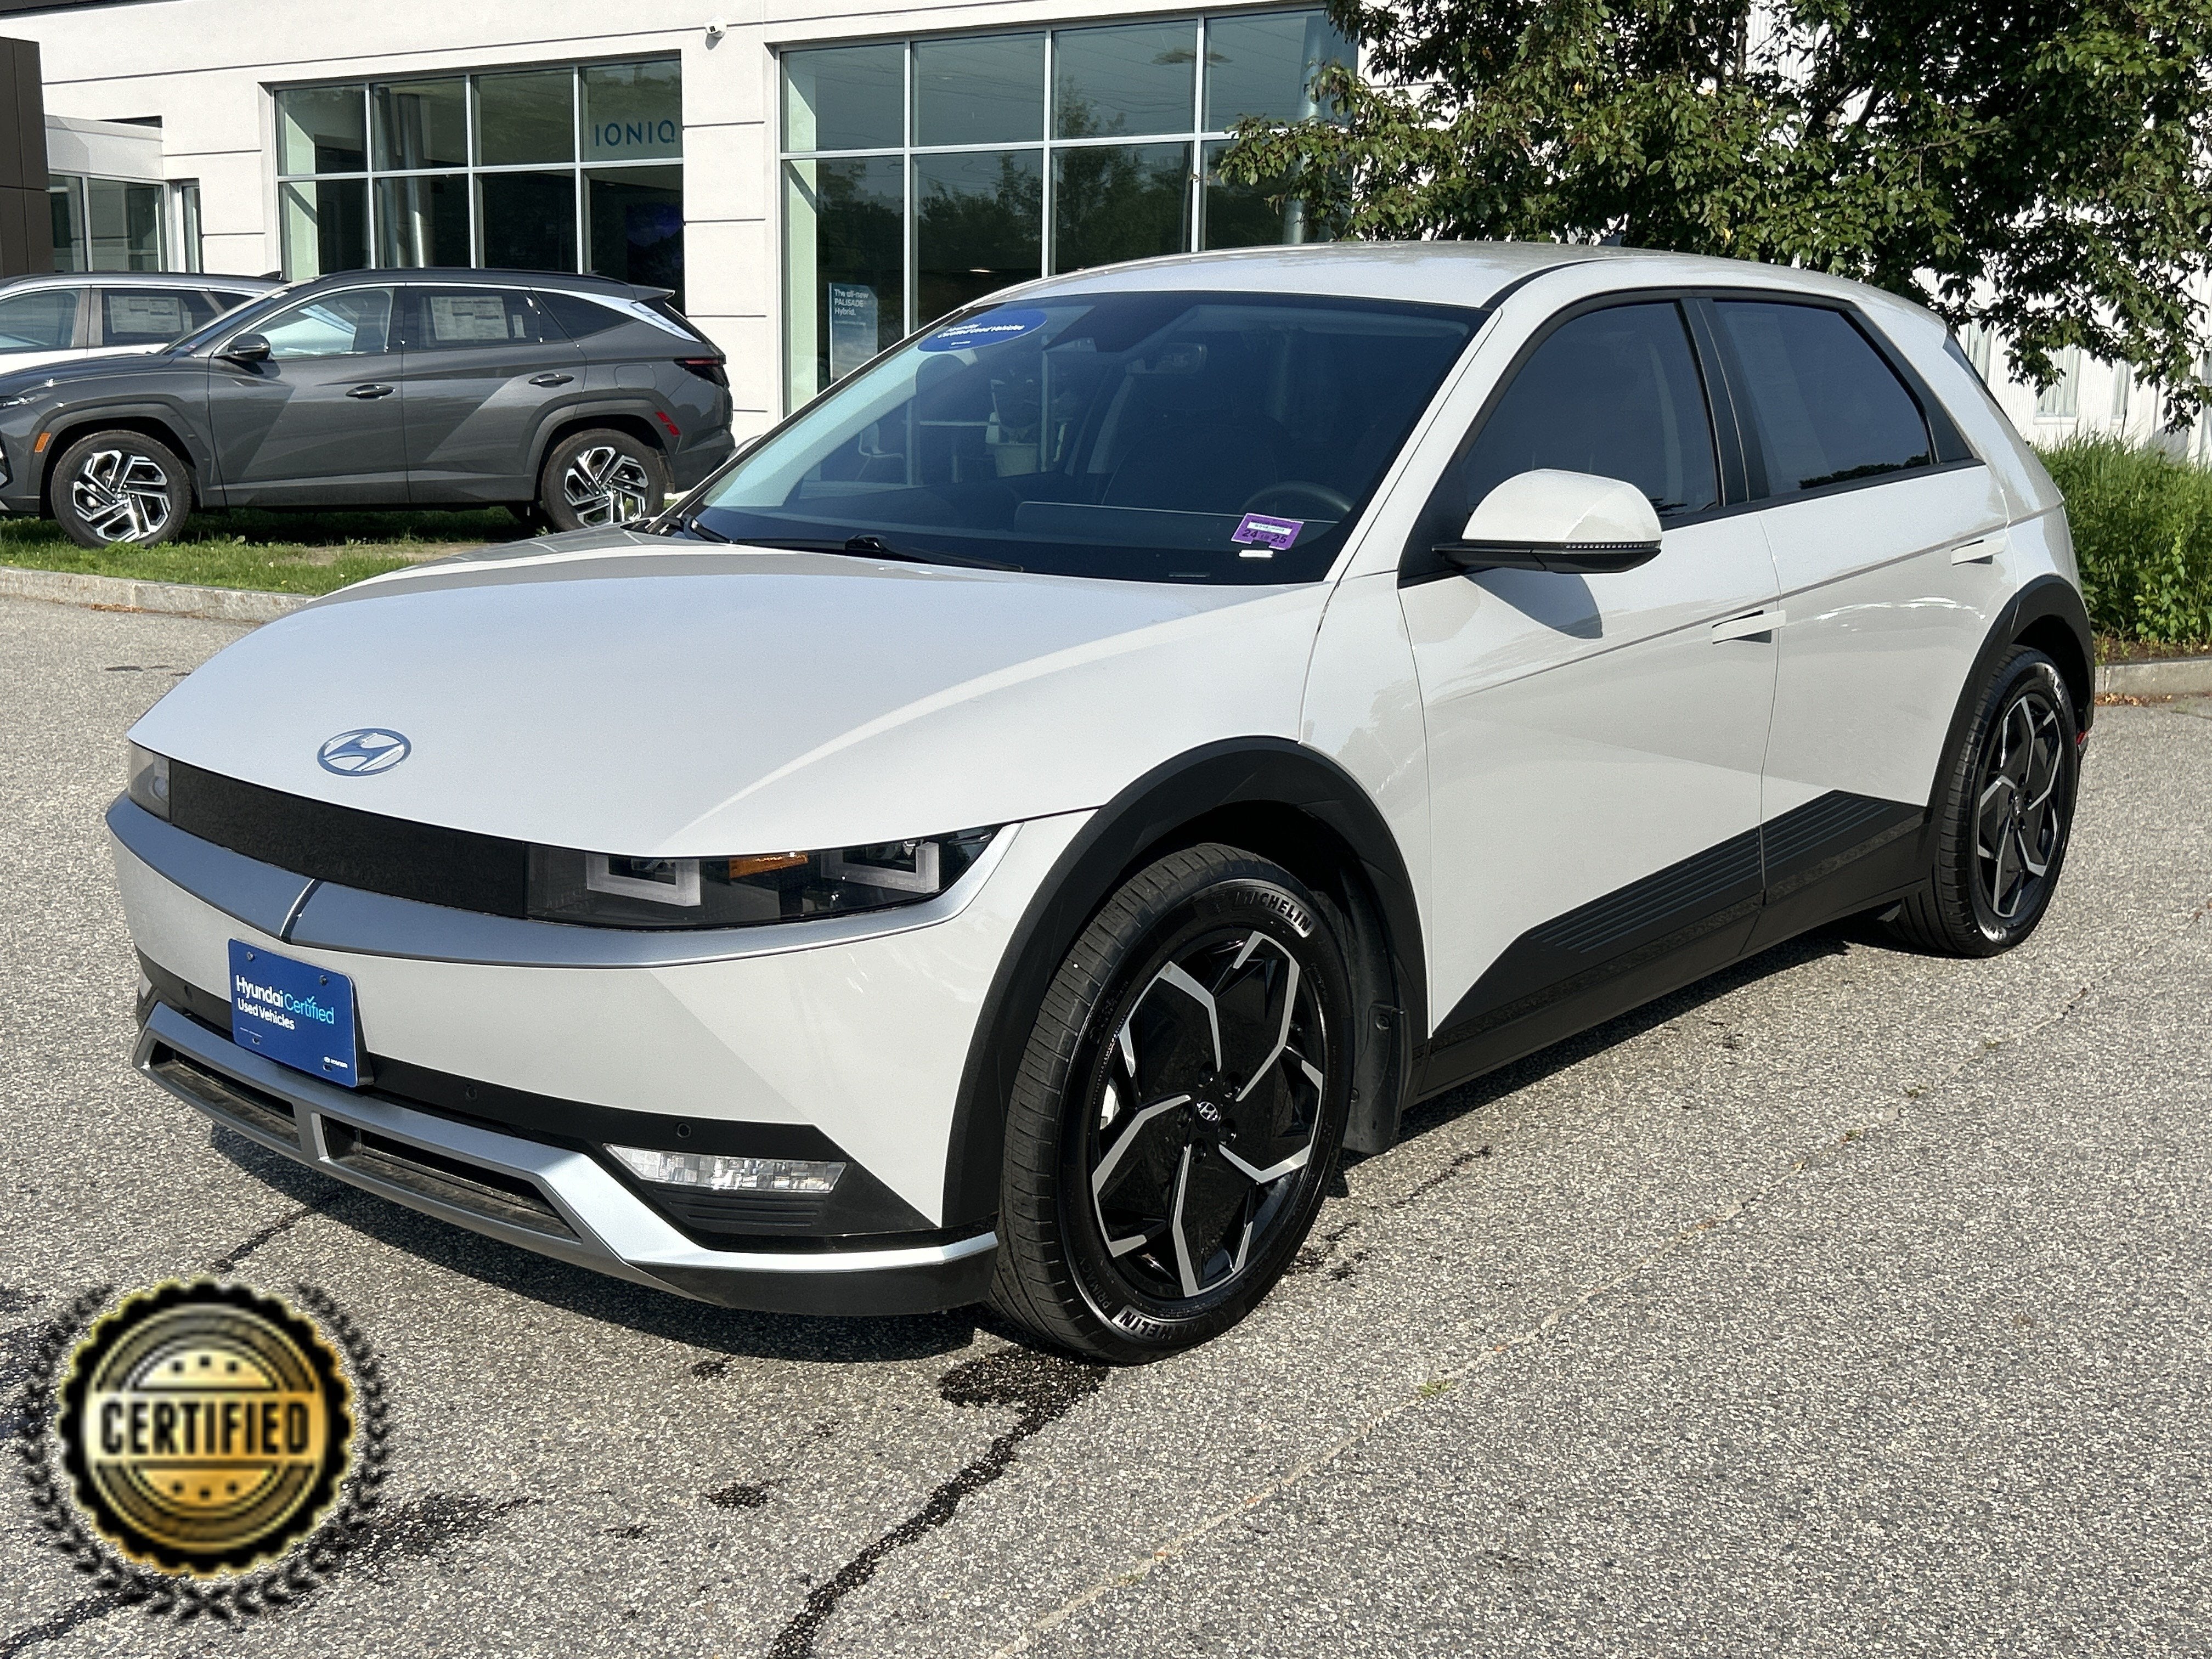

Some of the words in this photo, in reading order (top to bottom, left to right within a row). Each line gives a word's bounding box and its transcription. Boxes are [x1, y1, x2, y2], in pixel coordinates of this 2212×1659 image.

[595, 120, 675, 146] IONIQ
[834, 289, 845, 297] The
[834, 298, 864, 307] PALISADE
[1242, 529, 1258, 538] 24
[1271, 534, 1286, 543] 25
[1235, 891, 1313, 932] MICHELIN
[236, 975, 284, 1008] Hyundai
[284, 993, 334, 1024] Certified
[238, 997, 259, 1017] Used
[259, 1005, 295, 1030] Vehicles
